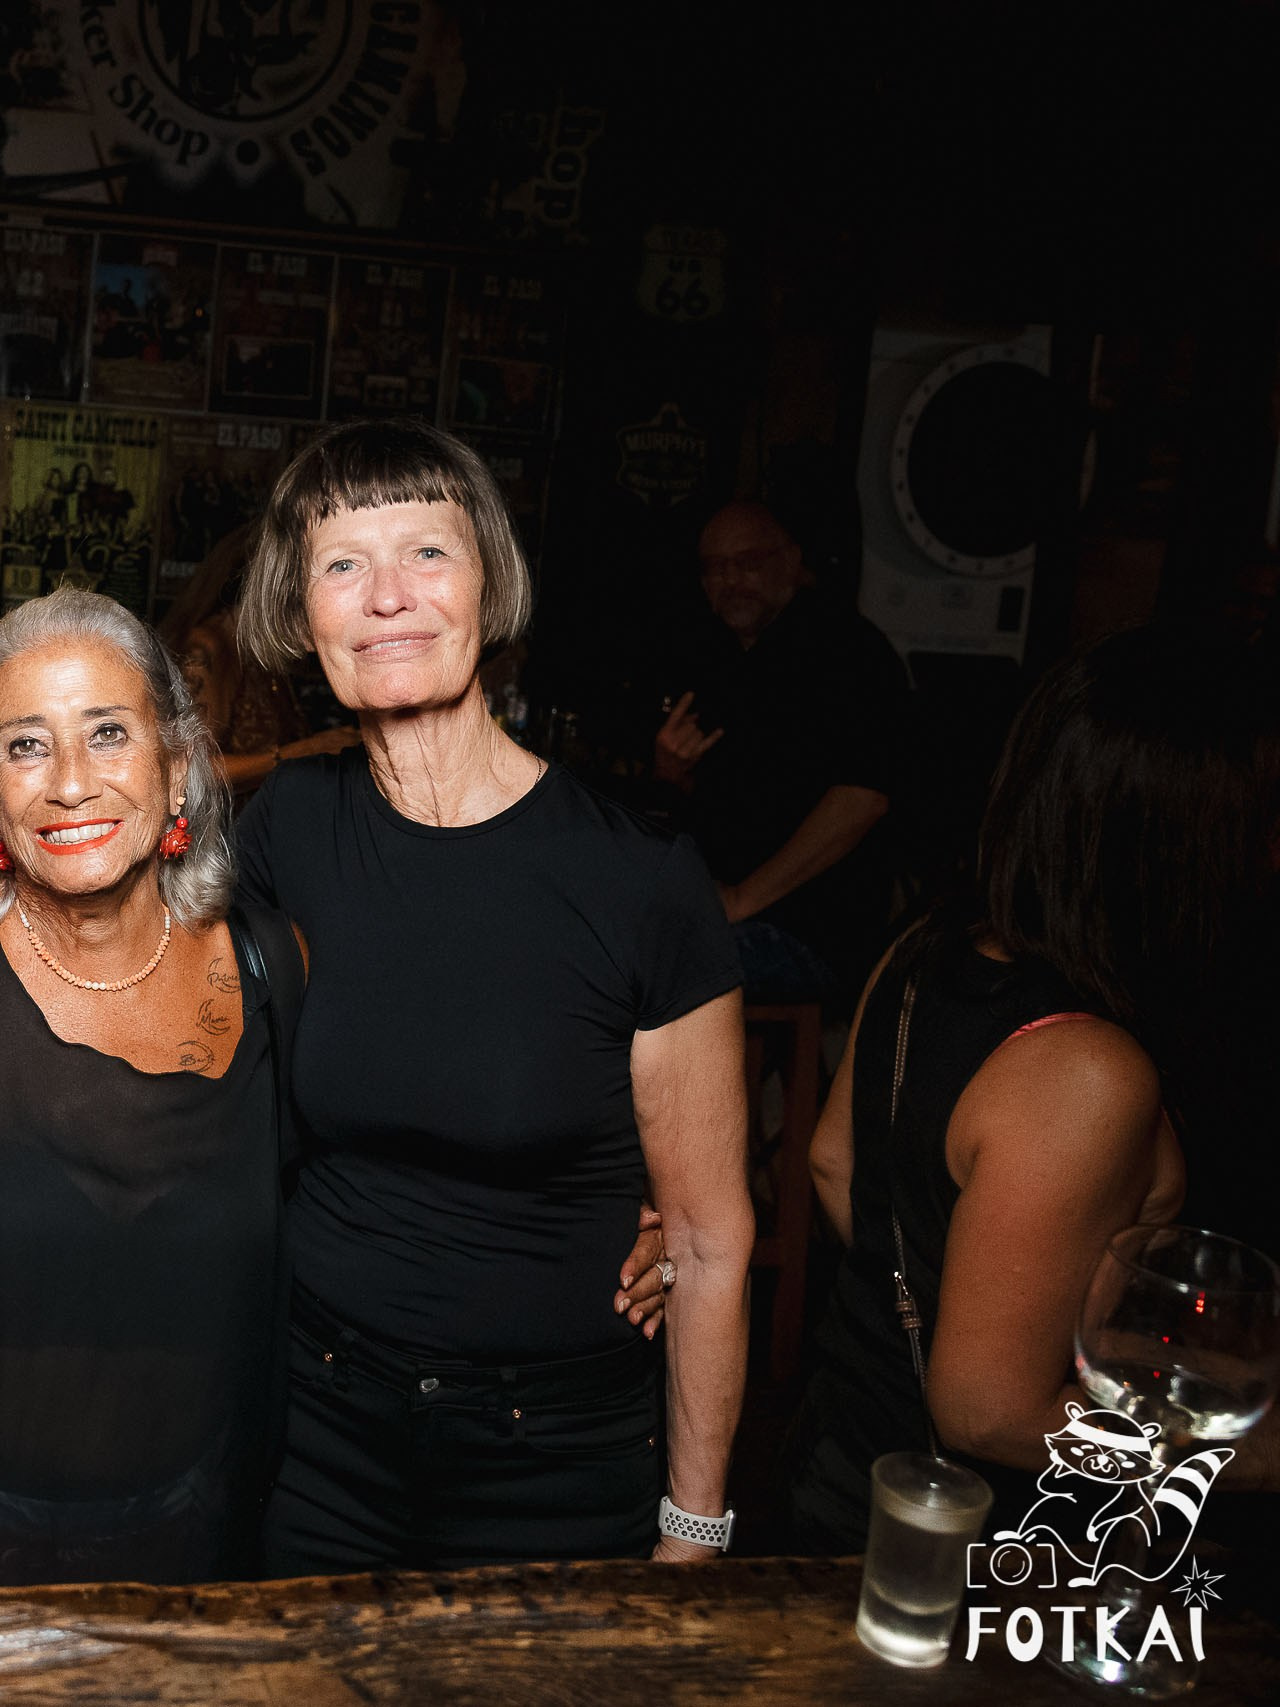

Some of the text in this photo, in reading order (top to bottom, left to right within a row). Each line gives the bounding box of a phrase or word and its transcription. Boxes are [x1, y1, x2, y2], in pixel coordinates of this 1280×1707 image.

[108, 73, 210, 165] Shop
[656, 277, 710, 316] 66
[217, 423, 238, 447] EL
[239, 425, 282, 452] PASO
